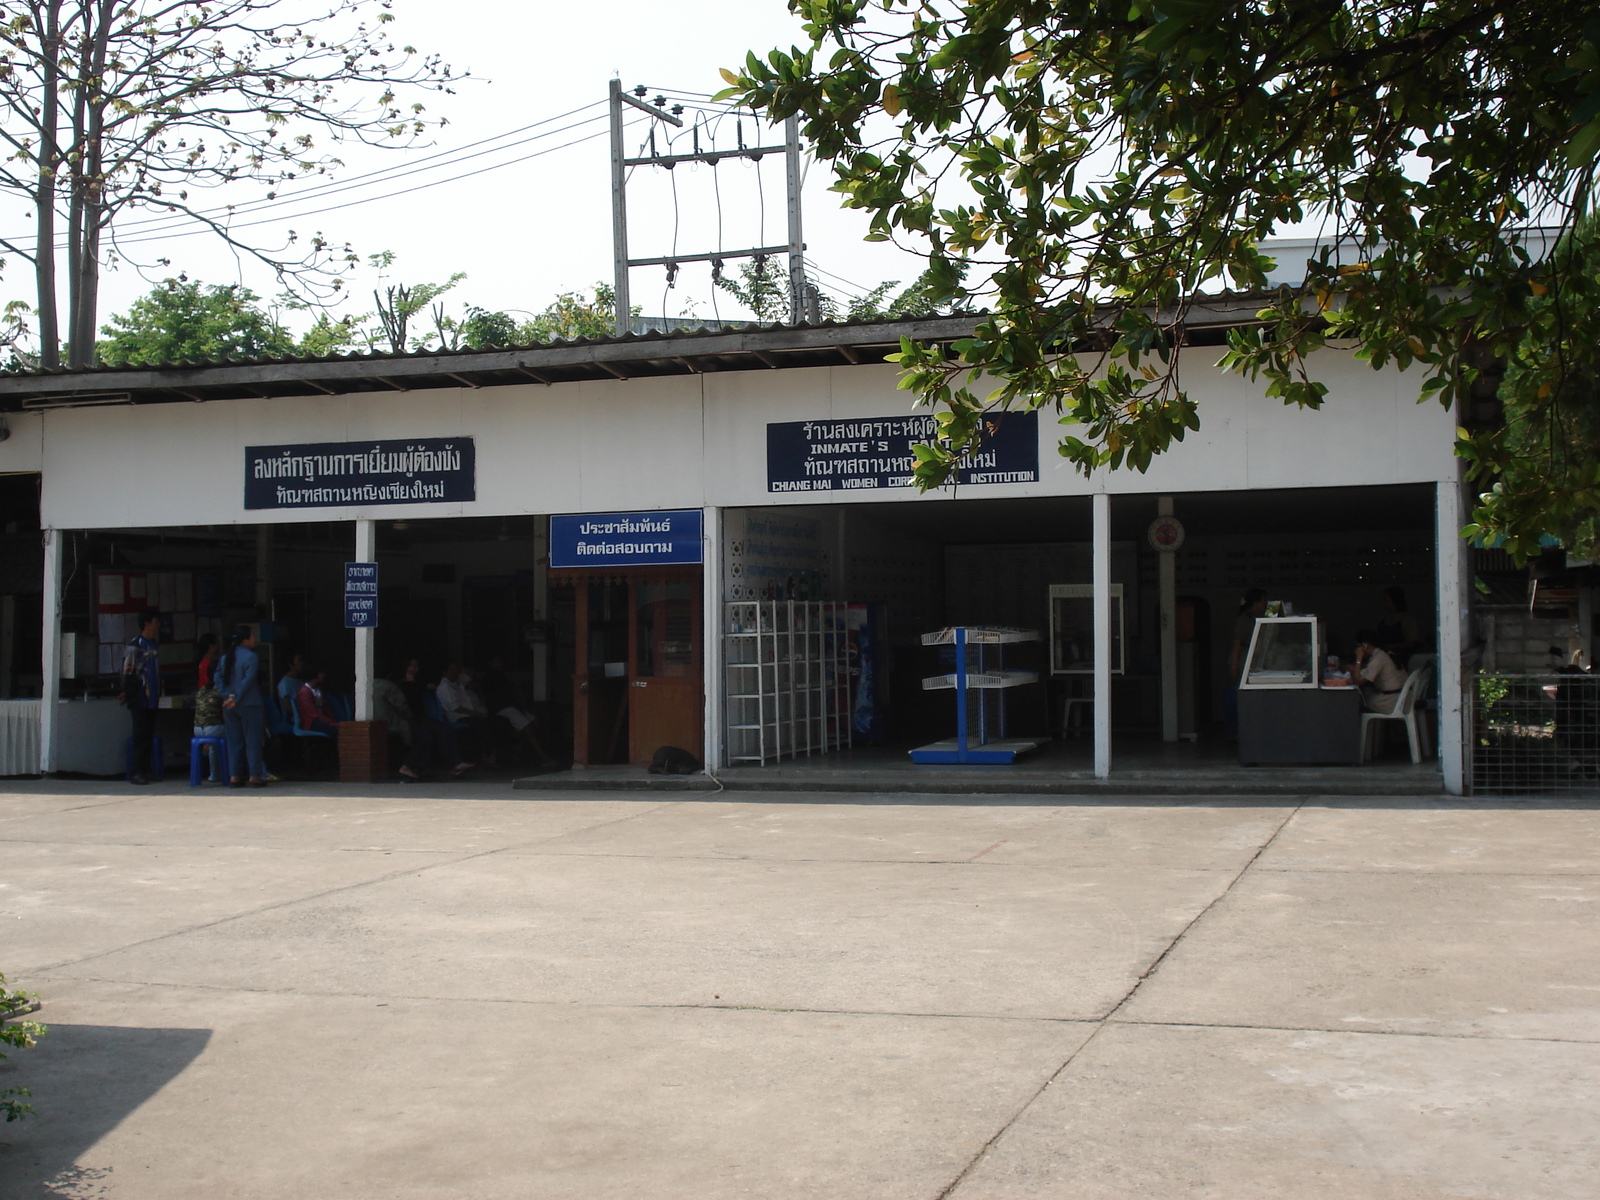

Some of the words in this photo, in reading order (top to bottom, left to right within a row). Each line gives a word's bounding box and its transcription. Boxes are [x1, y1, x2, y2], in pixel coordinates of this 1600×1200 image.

[803, 415, 983, 440] ร้านสงเคราะห์ผู้ต้ง
[276, 480, 444, 504] ทัณฑสถานหญิงเชียงใหม่
[772, 480, 811, 492] CHIANG
[813, 479, 832, 491] MAI
[841, 477, 878, 489] WOMEN
[970, 470, 1034, 484] INSTITUTION
[579, 517, 671, 535] ประชาสัมพันธ์
[576, 540, 672, 555] ติดต่อสอบถาม
